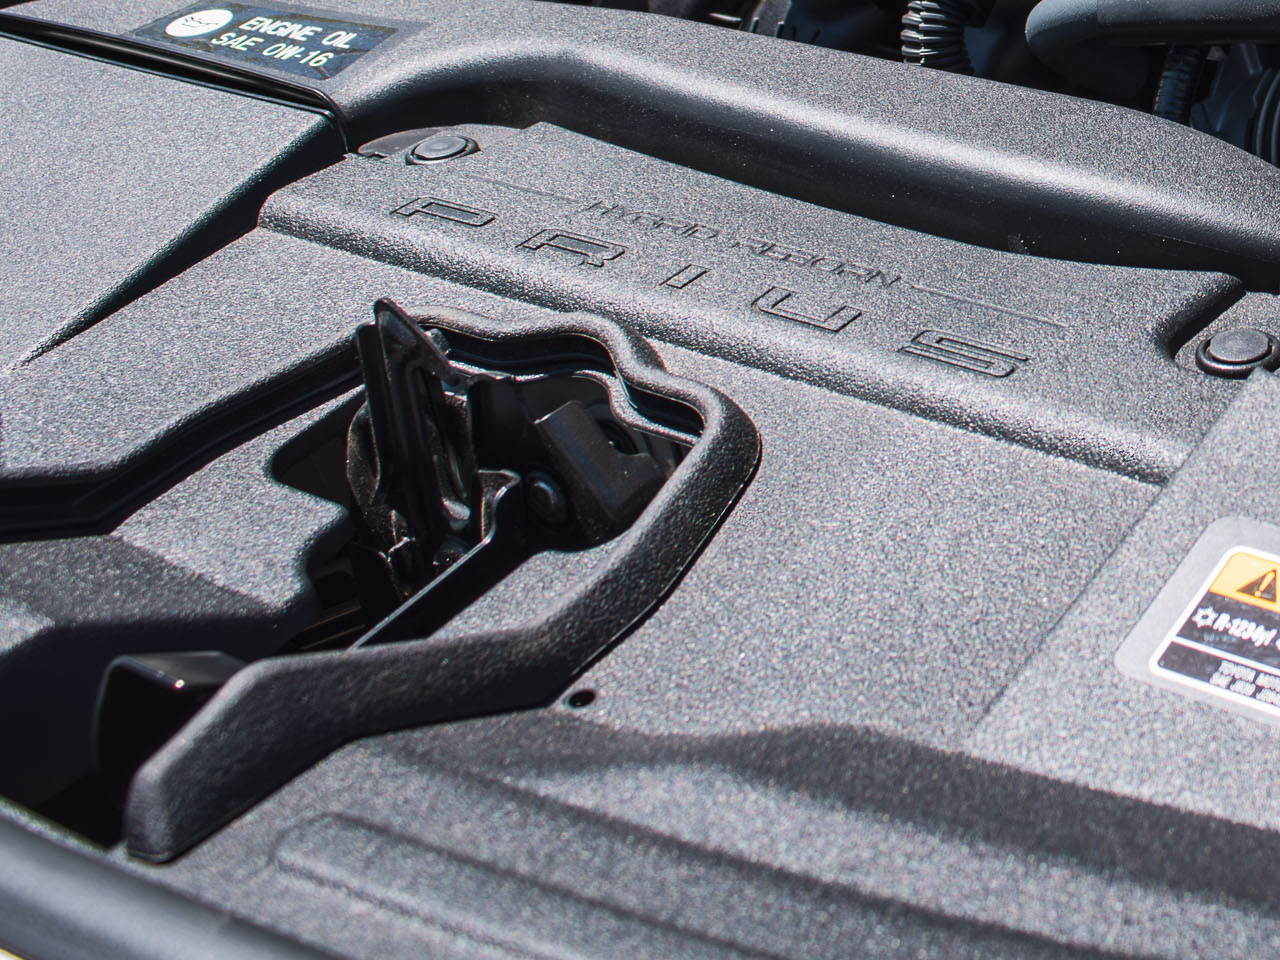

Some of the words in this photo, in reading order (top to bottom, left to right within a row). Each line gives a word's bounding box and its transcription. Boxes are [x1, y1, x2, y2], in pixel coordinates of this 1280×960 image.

[211, 32, 264, 51] SAE
[262, 43, 334, 67] 0W-16
[238, 16, 323, 41] ENGINE
[321, 31, 357, 49] OIL
[389, 195, 1033, 379] PRIUS
